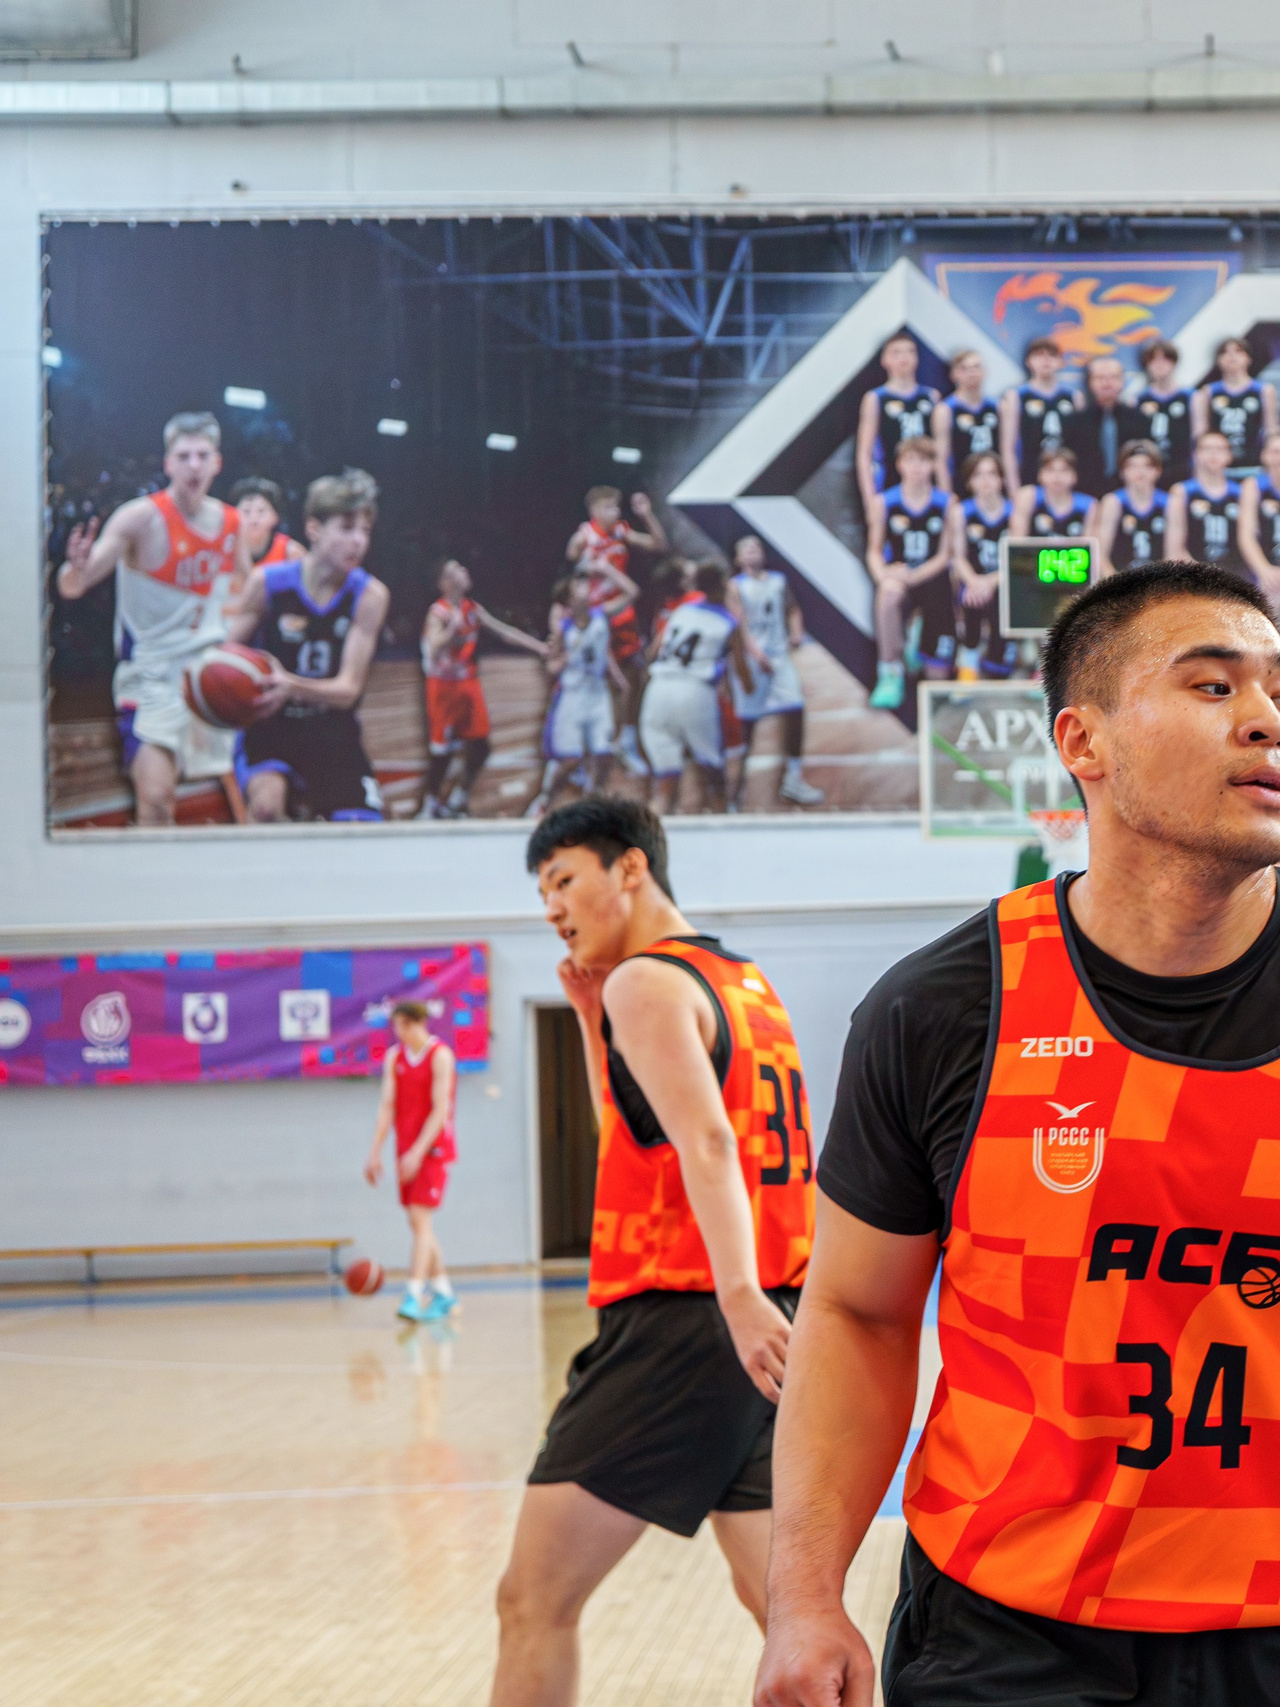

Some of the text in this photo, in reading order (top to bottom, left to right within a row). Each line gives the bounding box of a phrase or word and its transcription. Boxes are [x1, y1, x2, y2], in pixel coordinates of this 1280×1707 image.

[955, 709, 1052, 752] АРХ
[1020, 1036, 1094, 1058] ZEDO
[1048, 1127, 1090, 1146] РССС
[1116, 1341, 1251, 1470] 34
